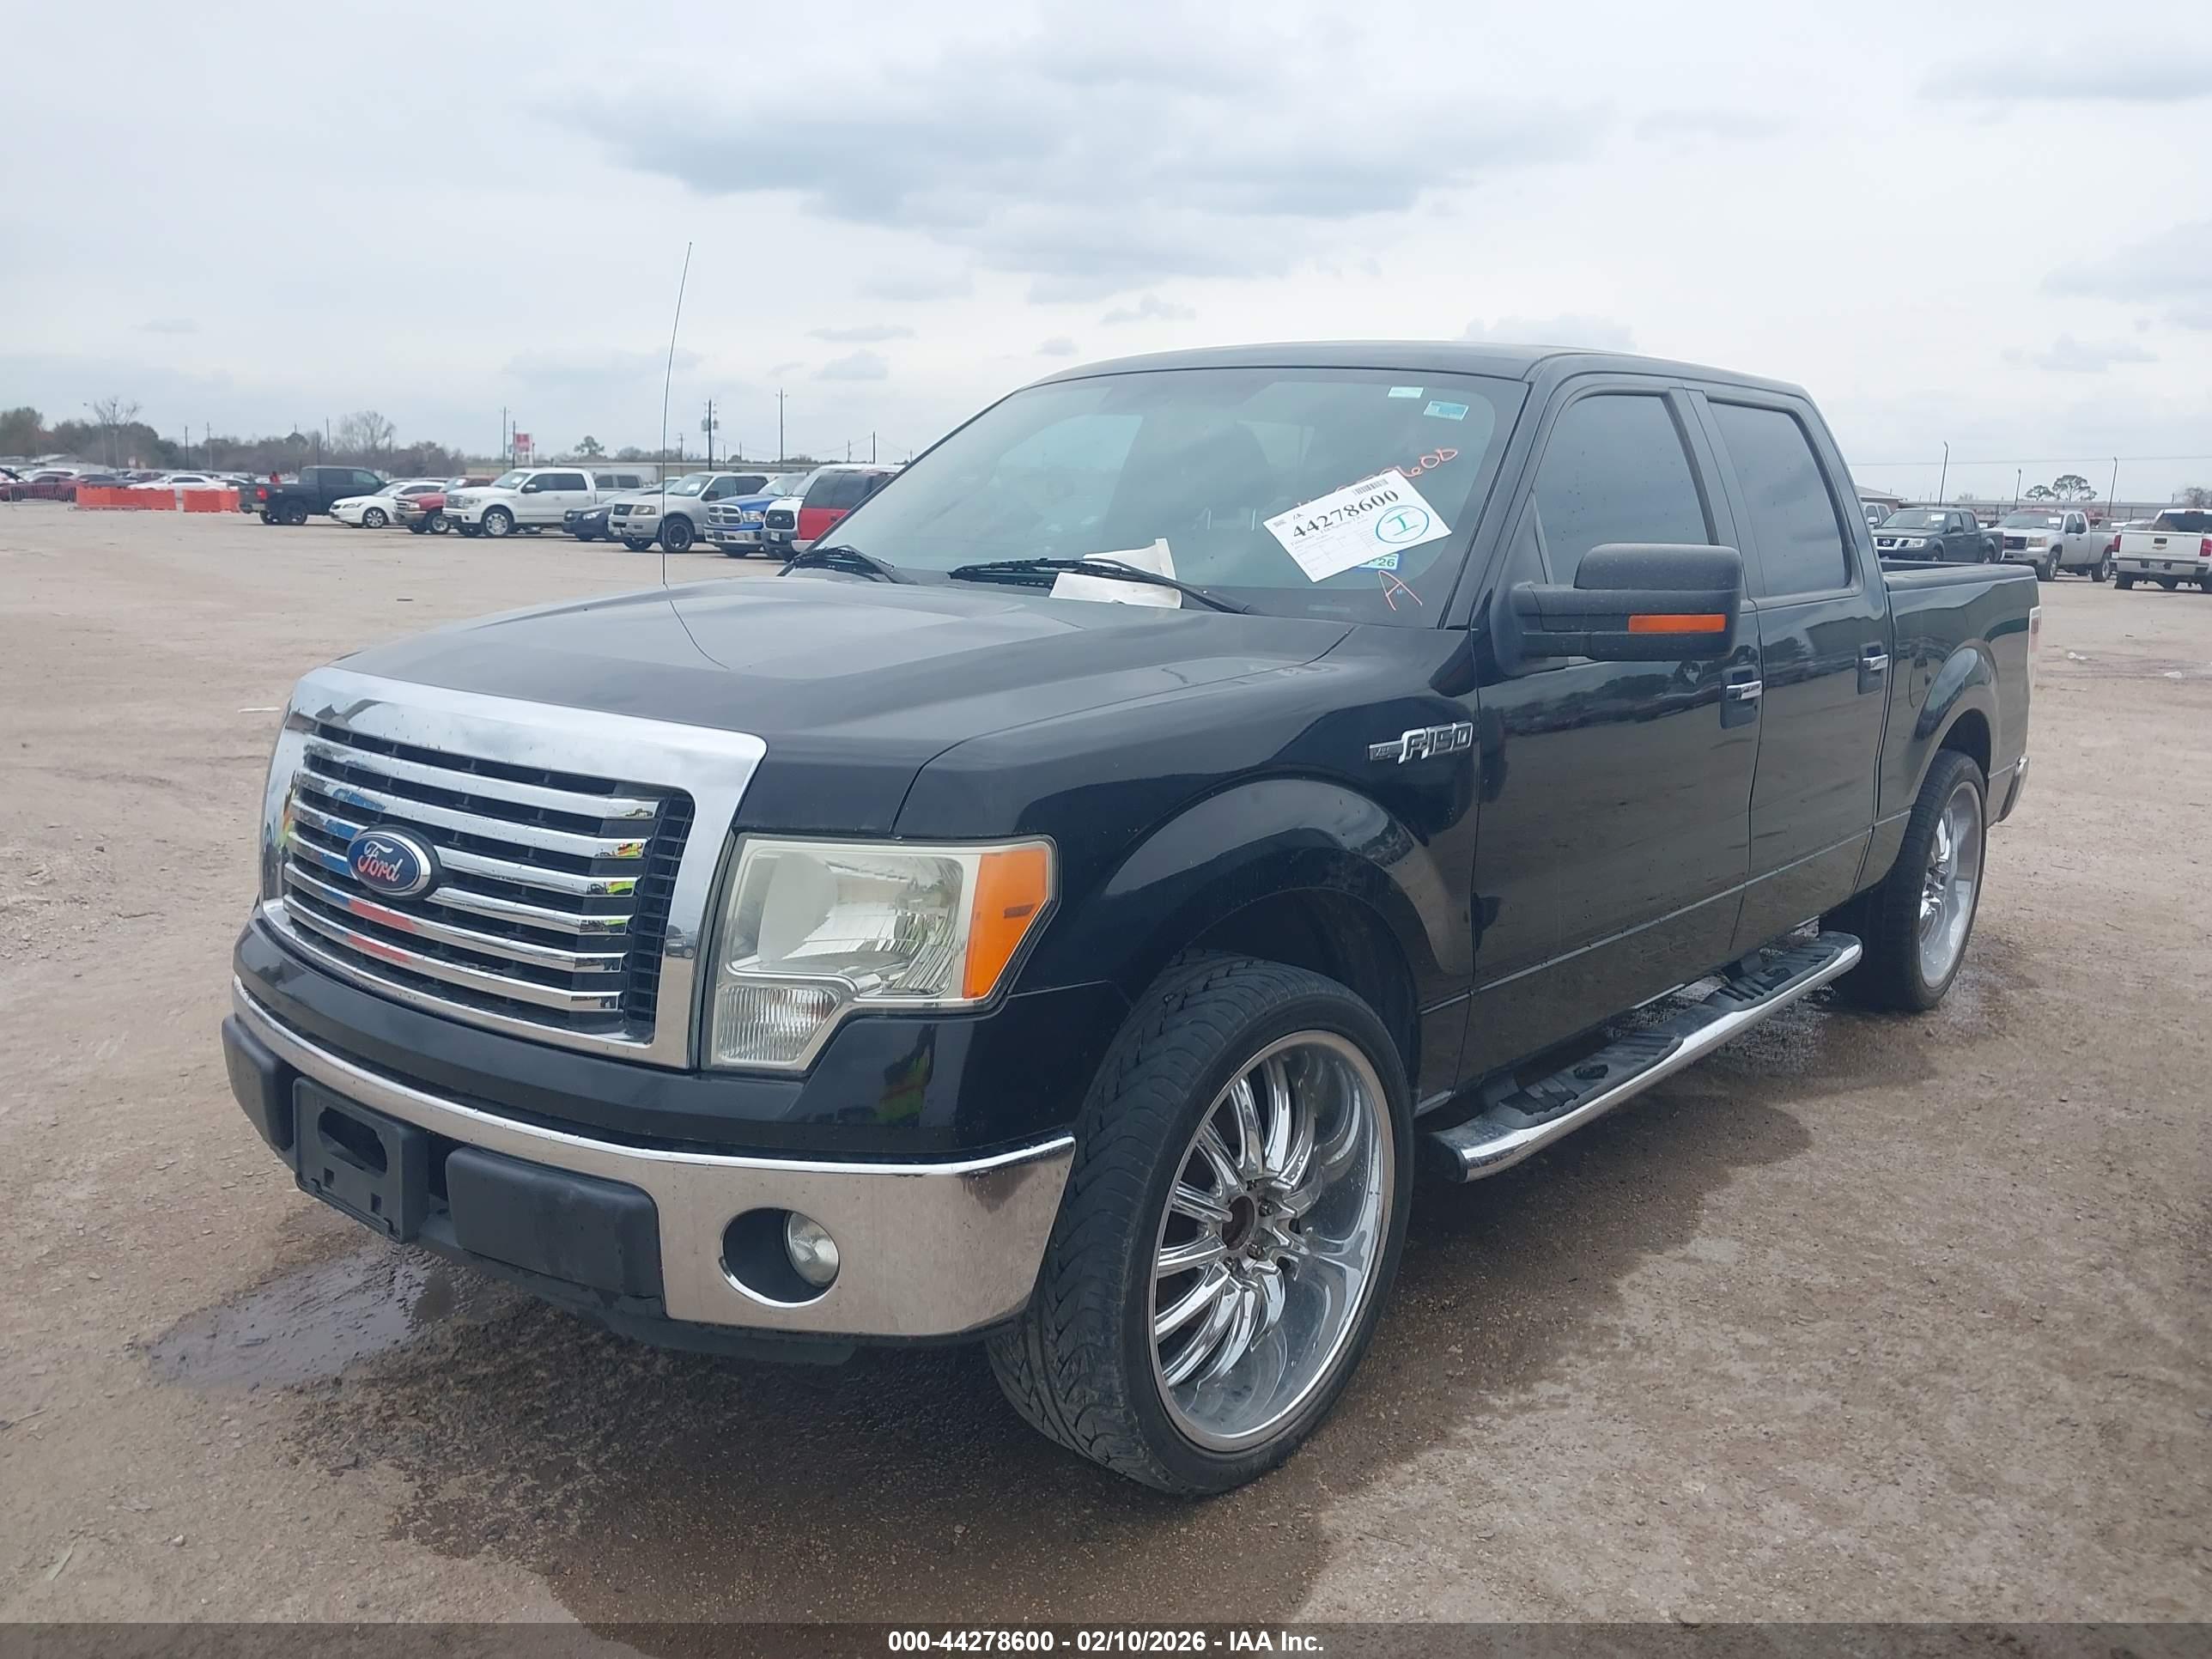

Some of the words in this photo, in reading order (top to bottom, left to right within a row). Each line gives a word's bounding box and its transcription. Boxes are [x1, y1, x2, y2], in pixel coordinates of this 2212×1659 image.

[1292, 489, 1400, 538] 44278600
[1377, 569, 1424, 611] A
[356, 840, 404, 883] Ford
